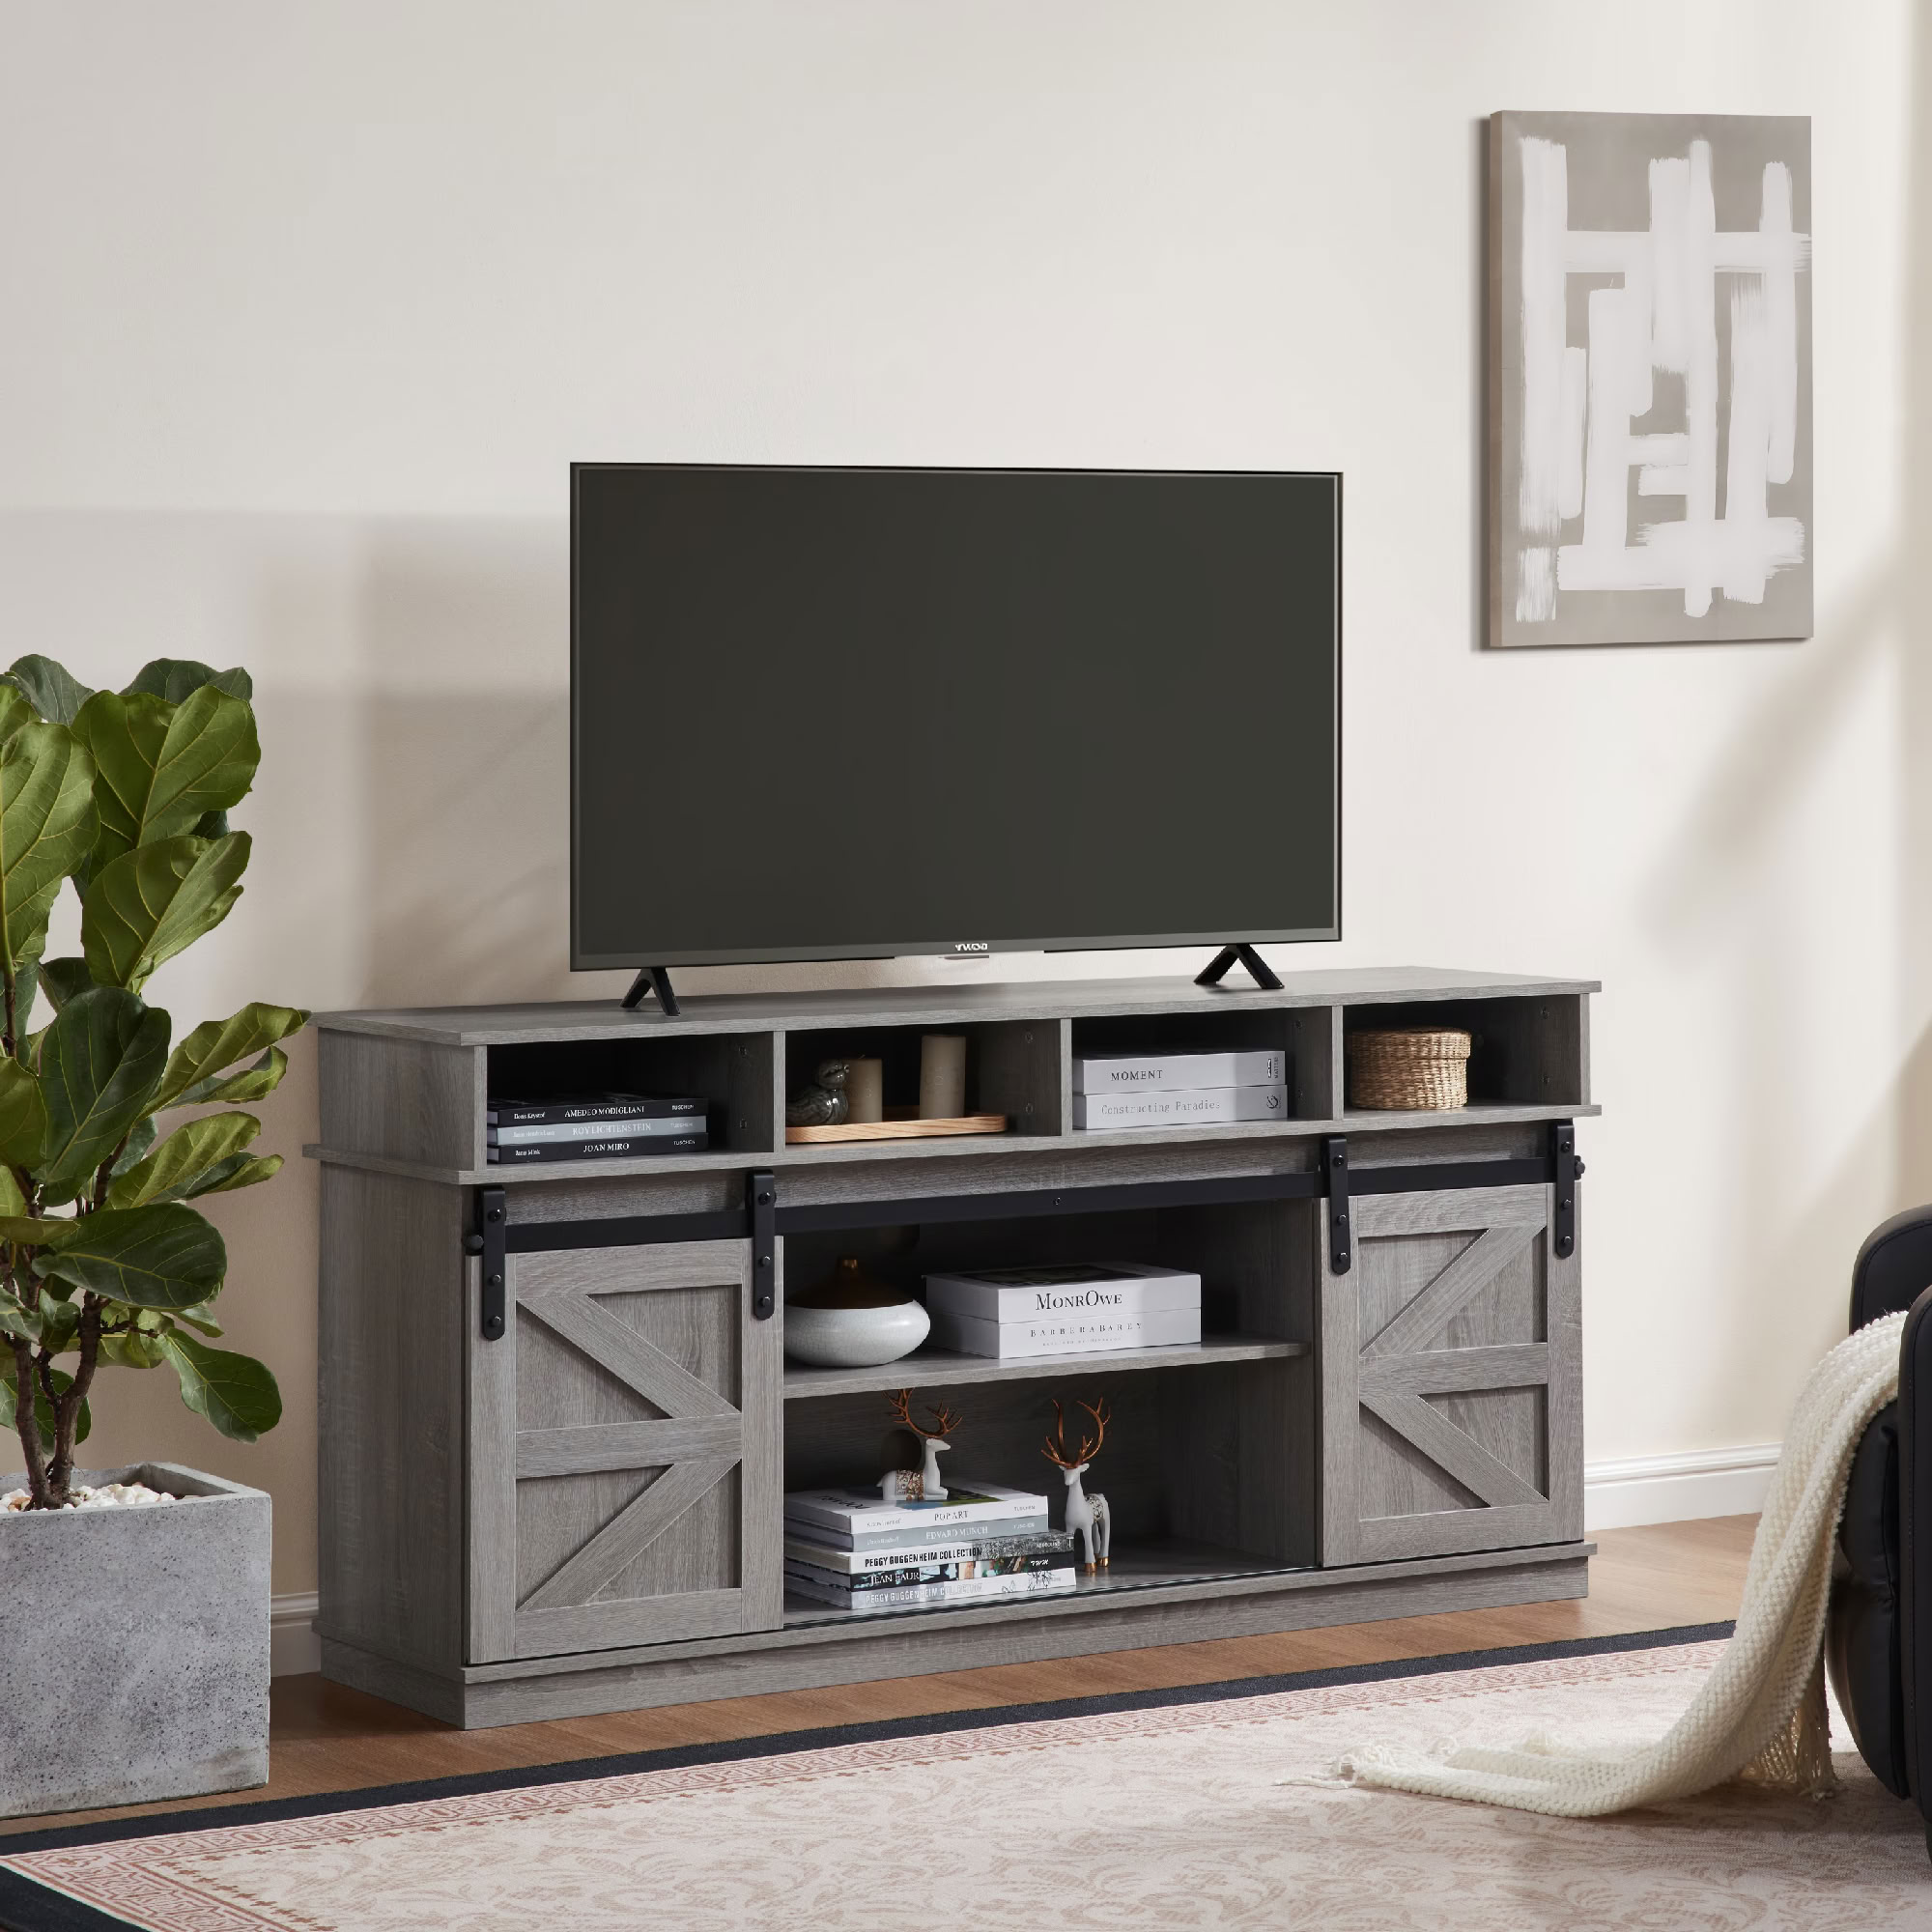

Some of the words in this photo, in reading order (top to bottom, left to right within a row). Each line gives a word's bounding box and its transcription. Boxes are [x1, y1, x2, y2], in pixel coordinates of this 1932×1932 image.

[1111, 1069, 1163, 1081] MOMENT
[564, 1108, 597, 1118] AMEDEO
[598, 1105, 644, 1116] MODIGLIANI
[1101, 1101, 1170, 1115] Constructing
[591, 1122, 651, 1134] LICHTENSTEIN
[582, 1144, 606, 1152] JOAN
[607, 1142, 630, 1151] MIRO
[952, 1510, 969, 1520] ART
[925, 1528, 958, 1541] EDVARD
[958, 1525, 988, 1537] MUNCH
[865, 1556, 889, 1568] PEGGY
[889, 1551, 938, 1565] GUGGENHEIM
[939, 1548, 982, 1560] COLLECTION
[869, 1574, 893, 1586] JEAN
[866, 1594, 889, 1605] PEGGY
[890, 1587, 938, 1601] GUGGENHEIM
